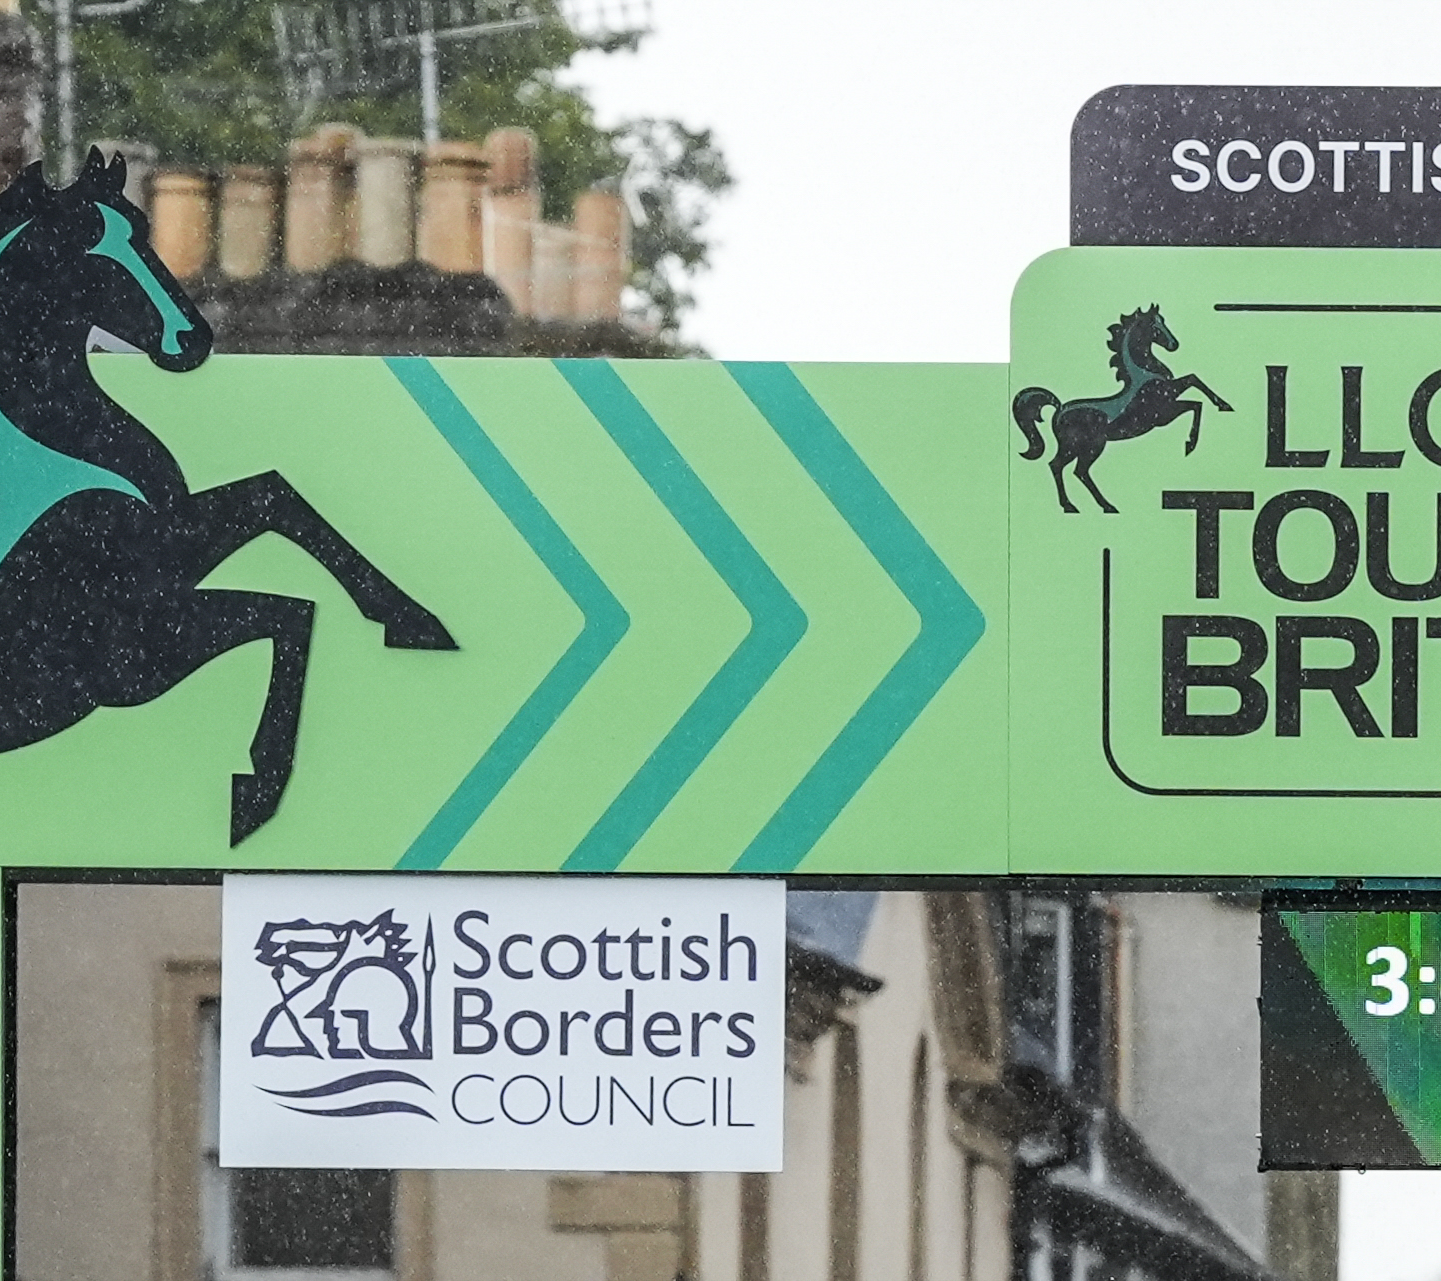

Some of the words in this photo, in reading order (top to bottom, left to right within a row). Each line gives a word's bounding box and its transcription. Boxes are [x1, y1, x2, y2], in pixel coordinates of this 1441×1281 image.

[452, 910, 758, 984] Scottish
[453, 988, 757, 1058] Borders
[451, 1072, 755, 1128] COUNCIL
